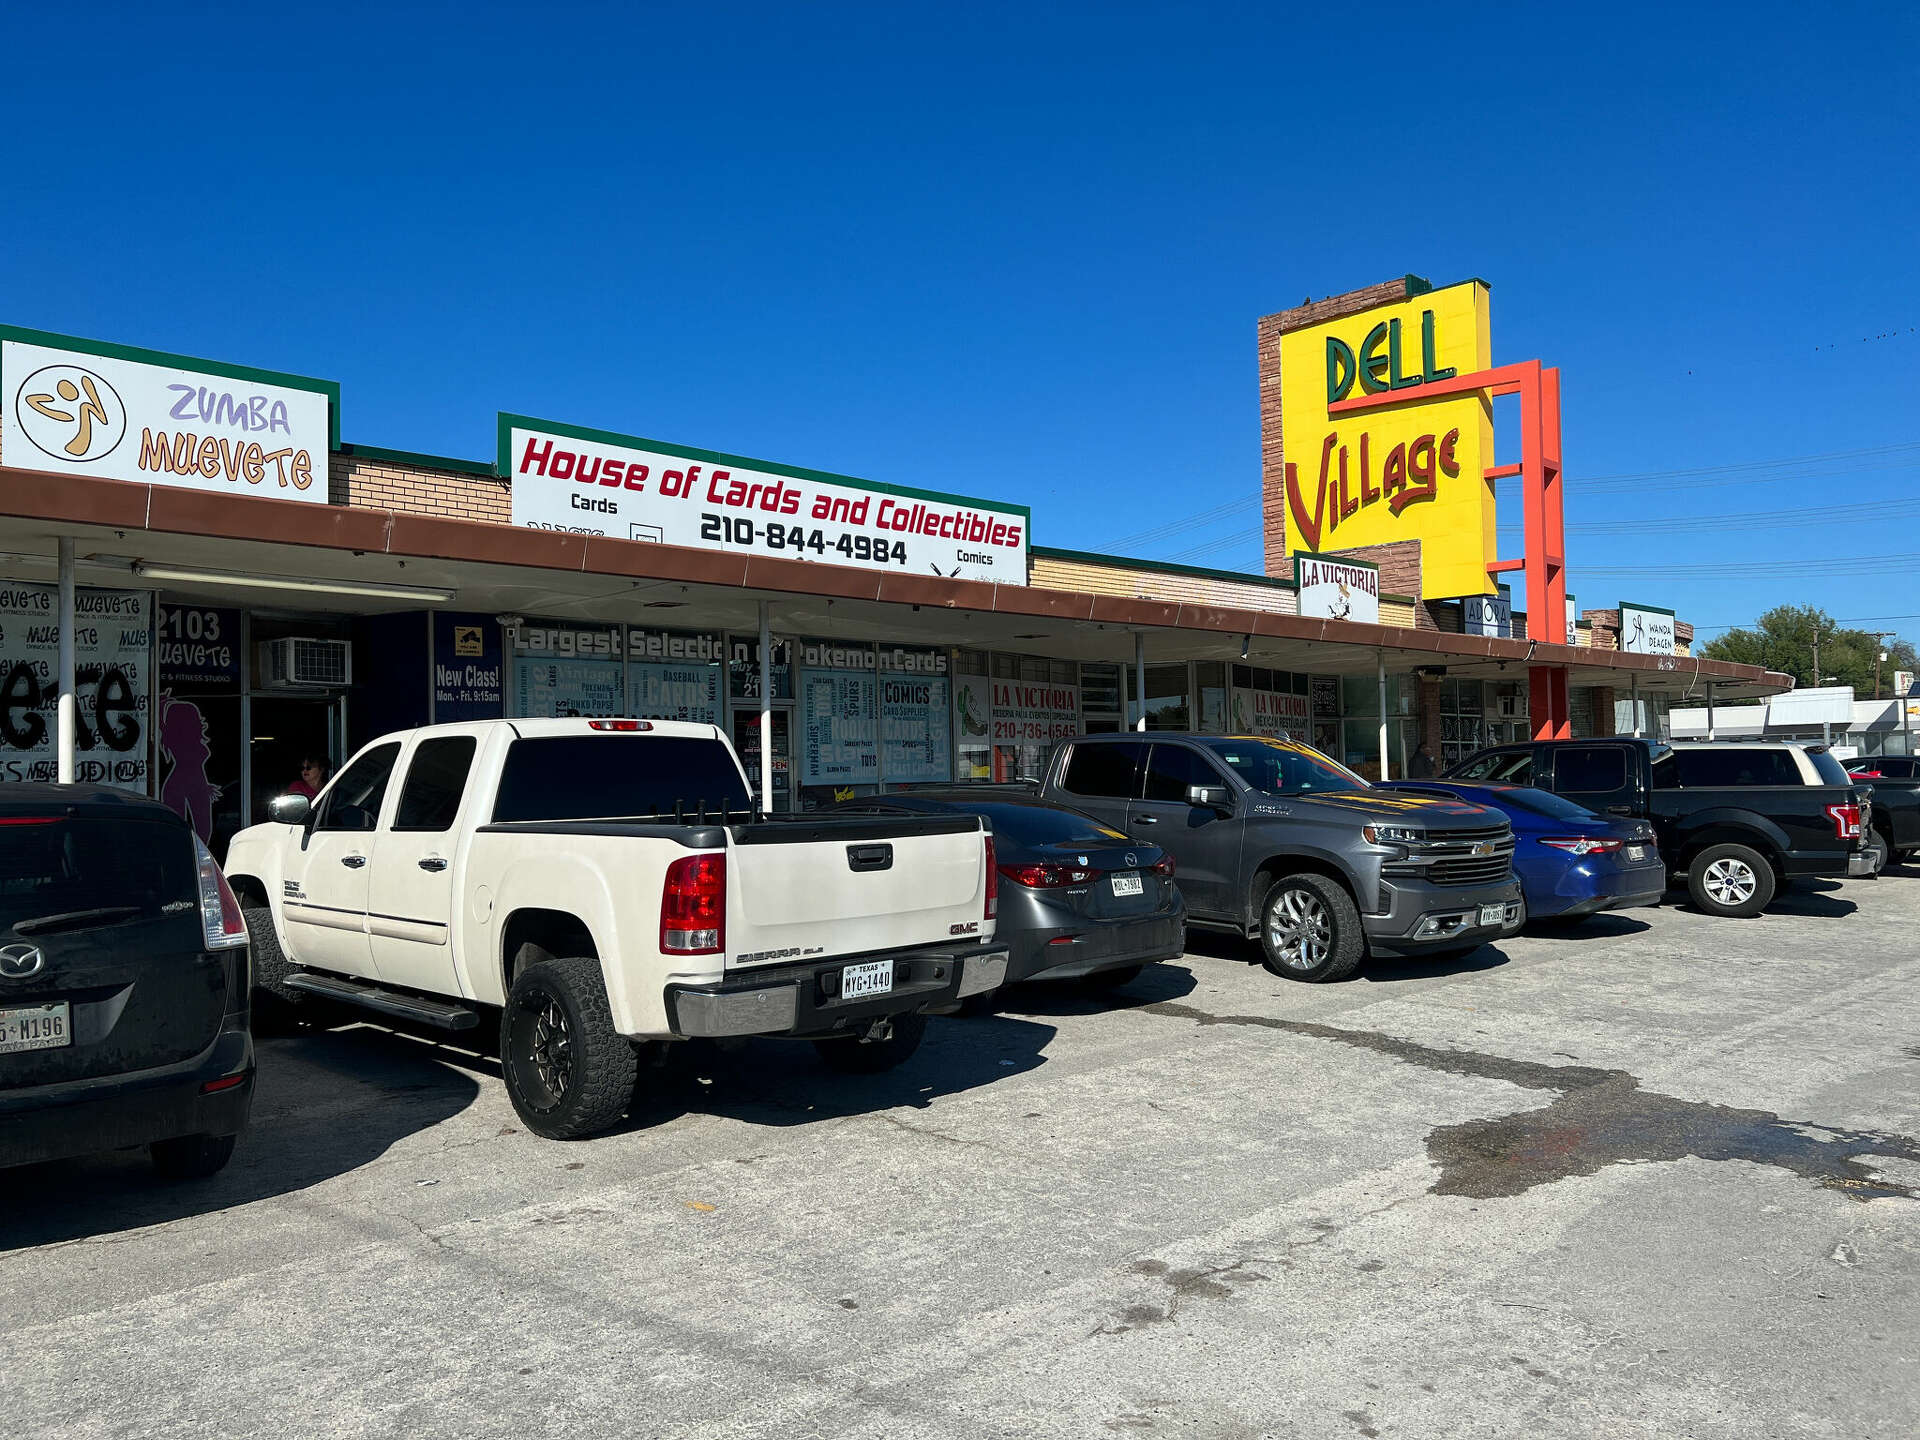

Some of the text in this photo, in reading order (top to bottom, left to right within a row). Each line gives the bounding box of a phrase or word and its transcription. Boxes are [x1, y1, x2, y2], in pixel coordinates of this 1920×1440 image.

[1326, 309, 1456, 403] DELL
[167, 383, 291, 435] ZUMBA
[519, 438, 1022, 548] House of Cards and Collectibles
[571, 492, 618, 515] Cards
[700, 512, 908, 566] 210-844-4984
[956, 548, 994, 567] Comics
[1302, 560, 1377, 598] LA VICTORIA
[160, 607, 221, 641] 2103
[1468, 600, 1507, 624] ADORA
[1648, 623, 1672, 635] WANDA
[514, 624, 623, 657] Largest
[896, 648, 948, 674] Cards
[1648, 636, 1672, 649] DEAGEN
[436, 664, 500, 688] New Class!
[663, 670, 702, 684] BASEBALL
[743, 684, 777, 698] 215
[849, 681, 860, 717] SPURS
[885, 682, 931, 705] COMICS
[993, 684, 1075, 711] LA VICTORIA
[1256, 693, 1267, 713] LA
[1270, 695, 1307, 717] VICTORIA
[810, 726, 820, 776] SUPERMAN
[861, 754, 878, 768] TOYS
[949, 920, 979, 936] GMC
[736, 947, 801, 964] SIERRA
[859, 964, 879, 972] TEXAS
